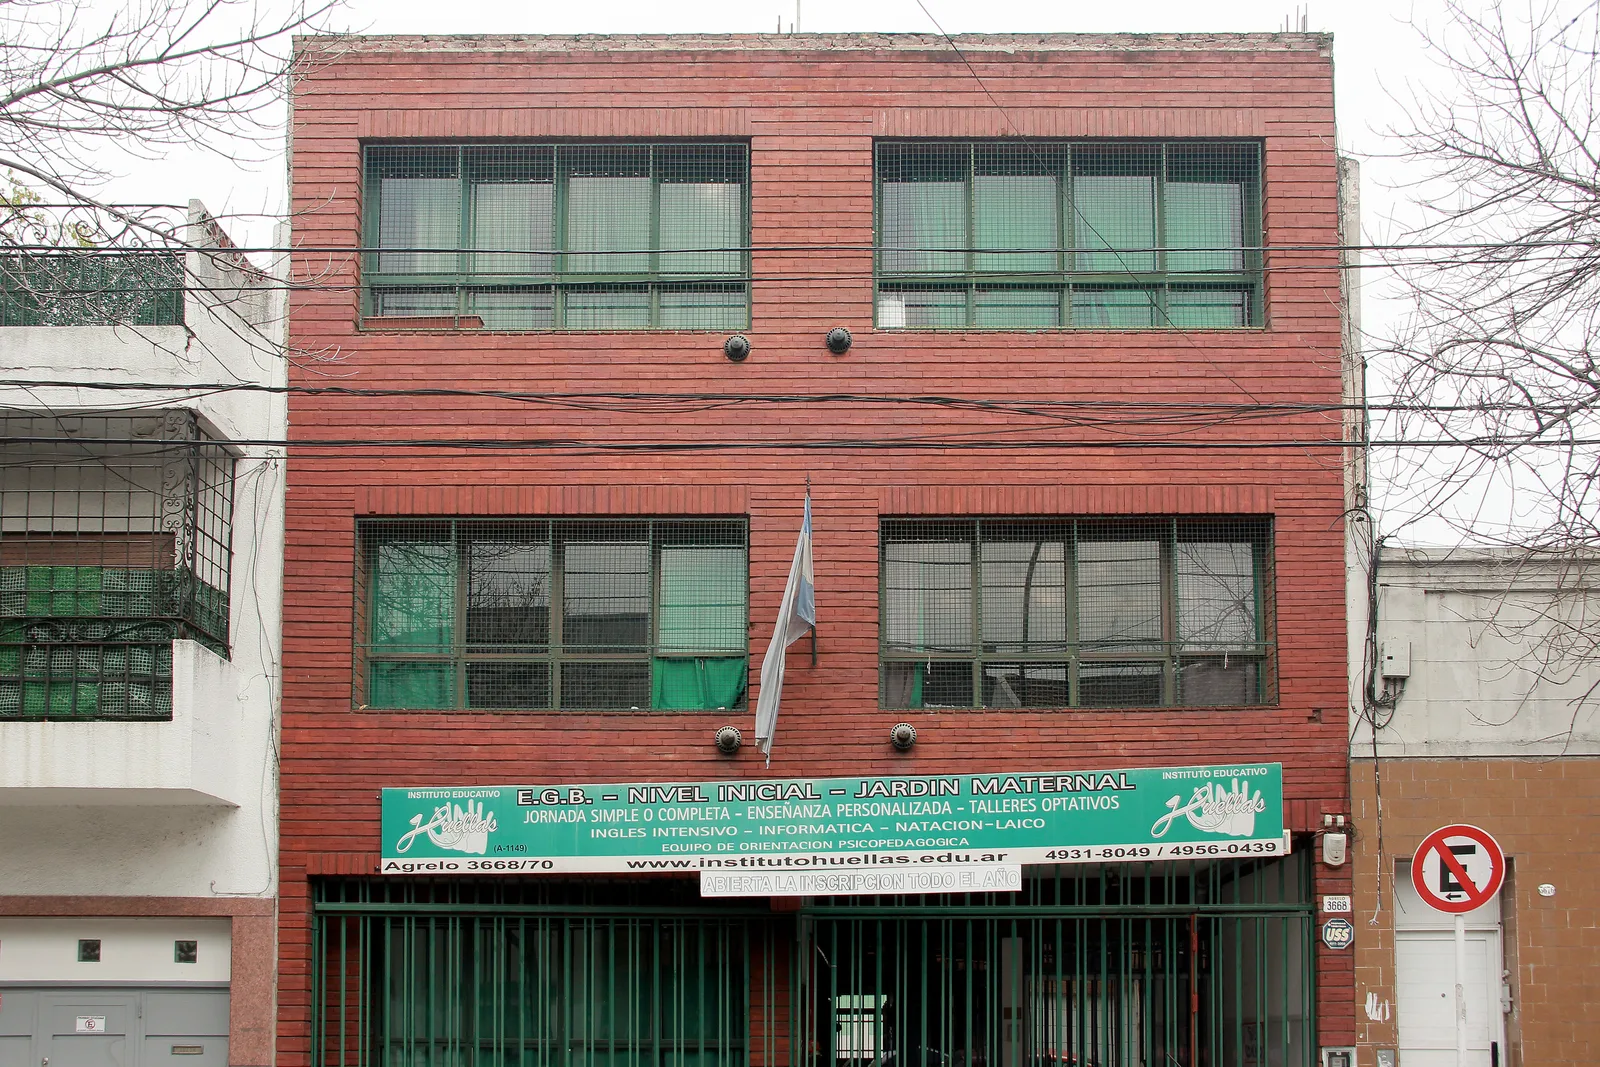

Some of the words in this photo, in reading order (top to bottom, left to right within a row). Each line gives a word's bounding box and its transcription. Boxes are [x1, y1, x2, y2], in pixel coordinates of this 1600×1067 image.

[1162, 770, 1211, 780] INSTITUTO
[1213, 767, 1268, 778] EDUCATIVO
[407, 791, 451, 799] INSTITUTO
[452, 790, 501, 798] EDUCATIVO
[517, 788, 593, 806] E.G.B.
[628, 786, 709, 804] NIVEL
[718, 783, 821, 802] INICIAL
[854, 778, 959, 798] JARDIN
[971, 773, 1136, 795] MATERNAL
[523, 809, 587, 824] JORNADA
[591, 808, 639, 822] SIMPLE
[643, 808, 653, 822] O
[658, 806, 731, 821] COMPLETA
[747, 802, 832, 820] ENSEÑANZA
[837, 801, 952, 817] PERSONALIZADA
[969, 798, 1037, 814] TALLERES
[1041, 795, 1120, 812] OPTATIVOS
[1151, 785, 1266, 838] Huellas
[396, 805, 499, 853] Huellas
[591, 827, 647, 838] INGLES
[652, 826, 738, 837] INTENSIVO
[759, 823, 874, 836] INFORMATICA
[493, 844, 528, 853] (A-1149)
[662, 843, 712, 852] EQUIPO
[717, 842, 735, 851] DE
[739, 840, 833, 851] ORIENTACION
[838, 837, 970, 849] PSICOPEDAGOGICA
[1045, 847, 1150, 860] 4931-8049
[1157, 846, 1163, 856] /
[1170, 842, 1277, 856] 4956-0439
[384, 861, 459, 873] Agrelo
[467, 860, 554, 870] 3668/70
[627, 852, 1008, 869] www.institutohuellas.edu.ar
[1439, 844, 1476, 893] E
[703, 876, 773, 893] ABIERTA
[775, 875, 798, 892] LA
[800, 873, 905, 892] INSCRIPCION
[908, 872, 955, 890] TODO
[959, 871, 981, 887] EL
[983, 868, 1020, 887] AÑO
[1327, 900, 1348, 911] 3668
[1326, 927, 1350, 942] USS
